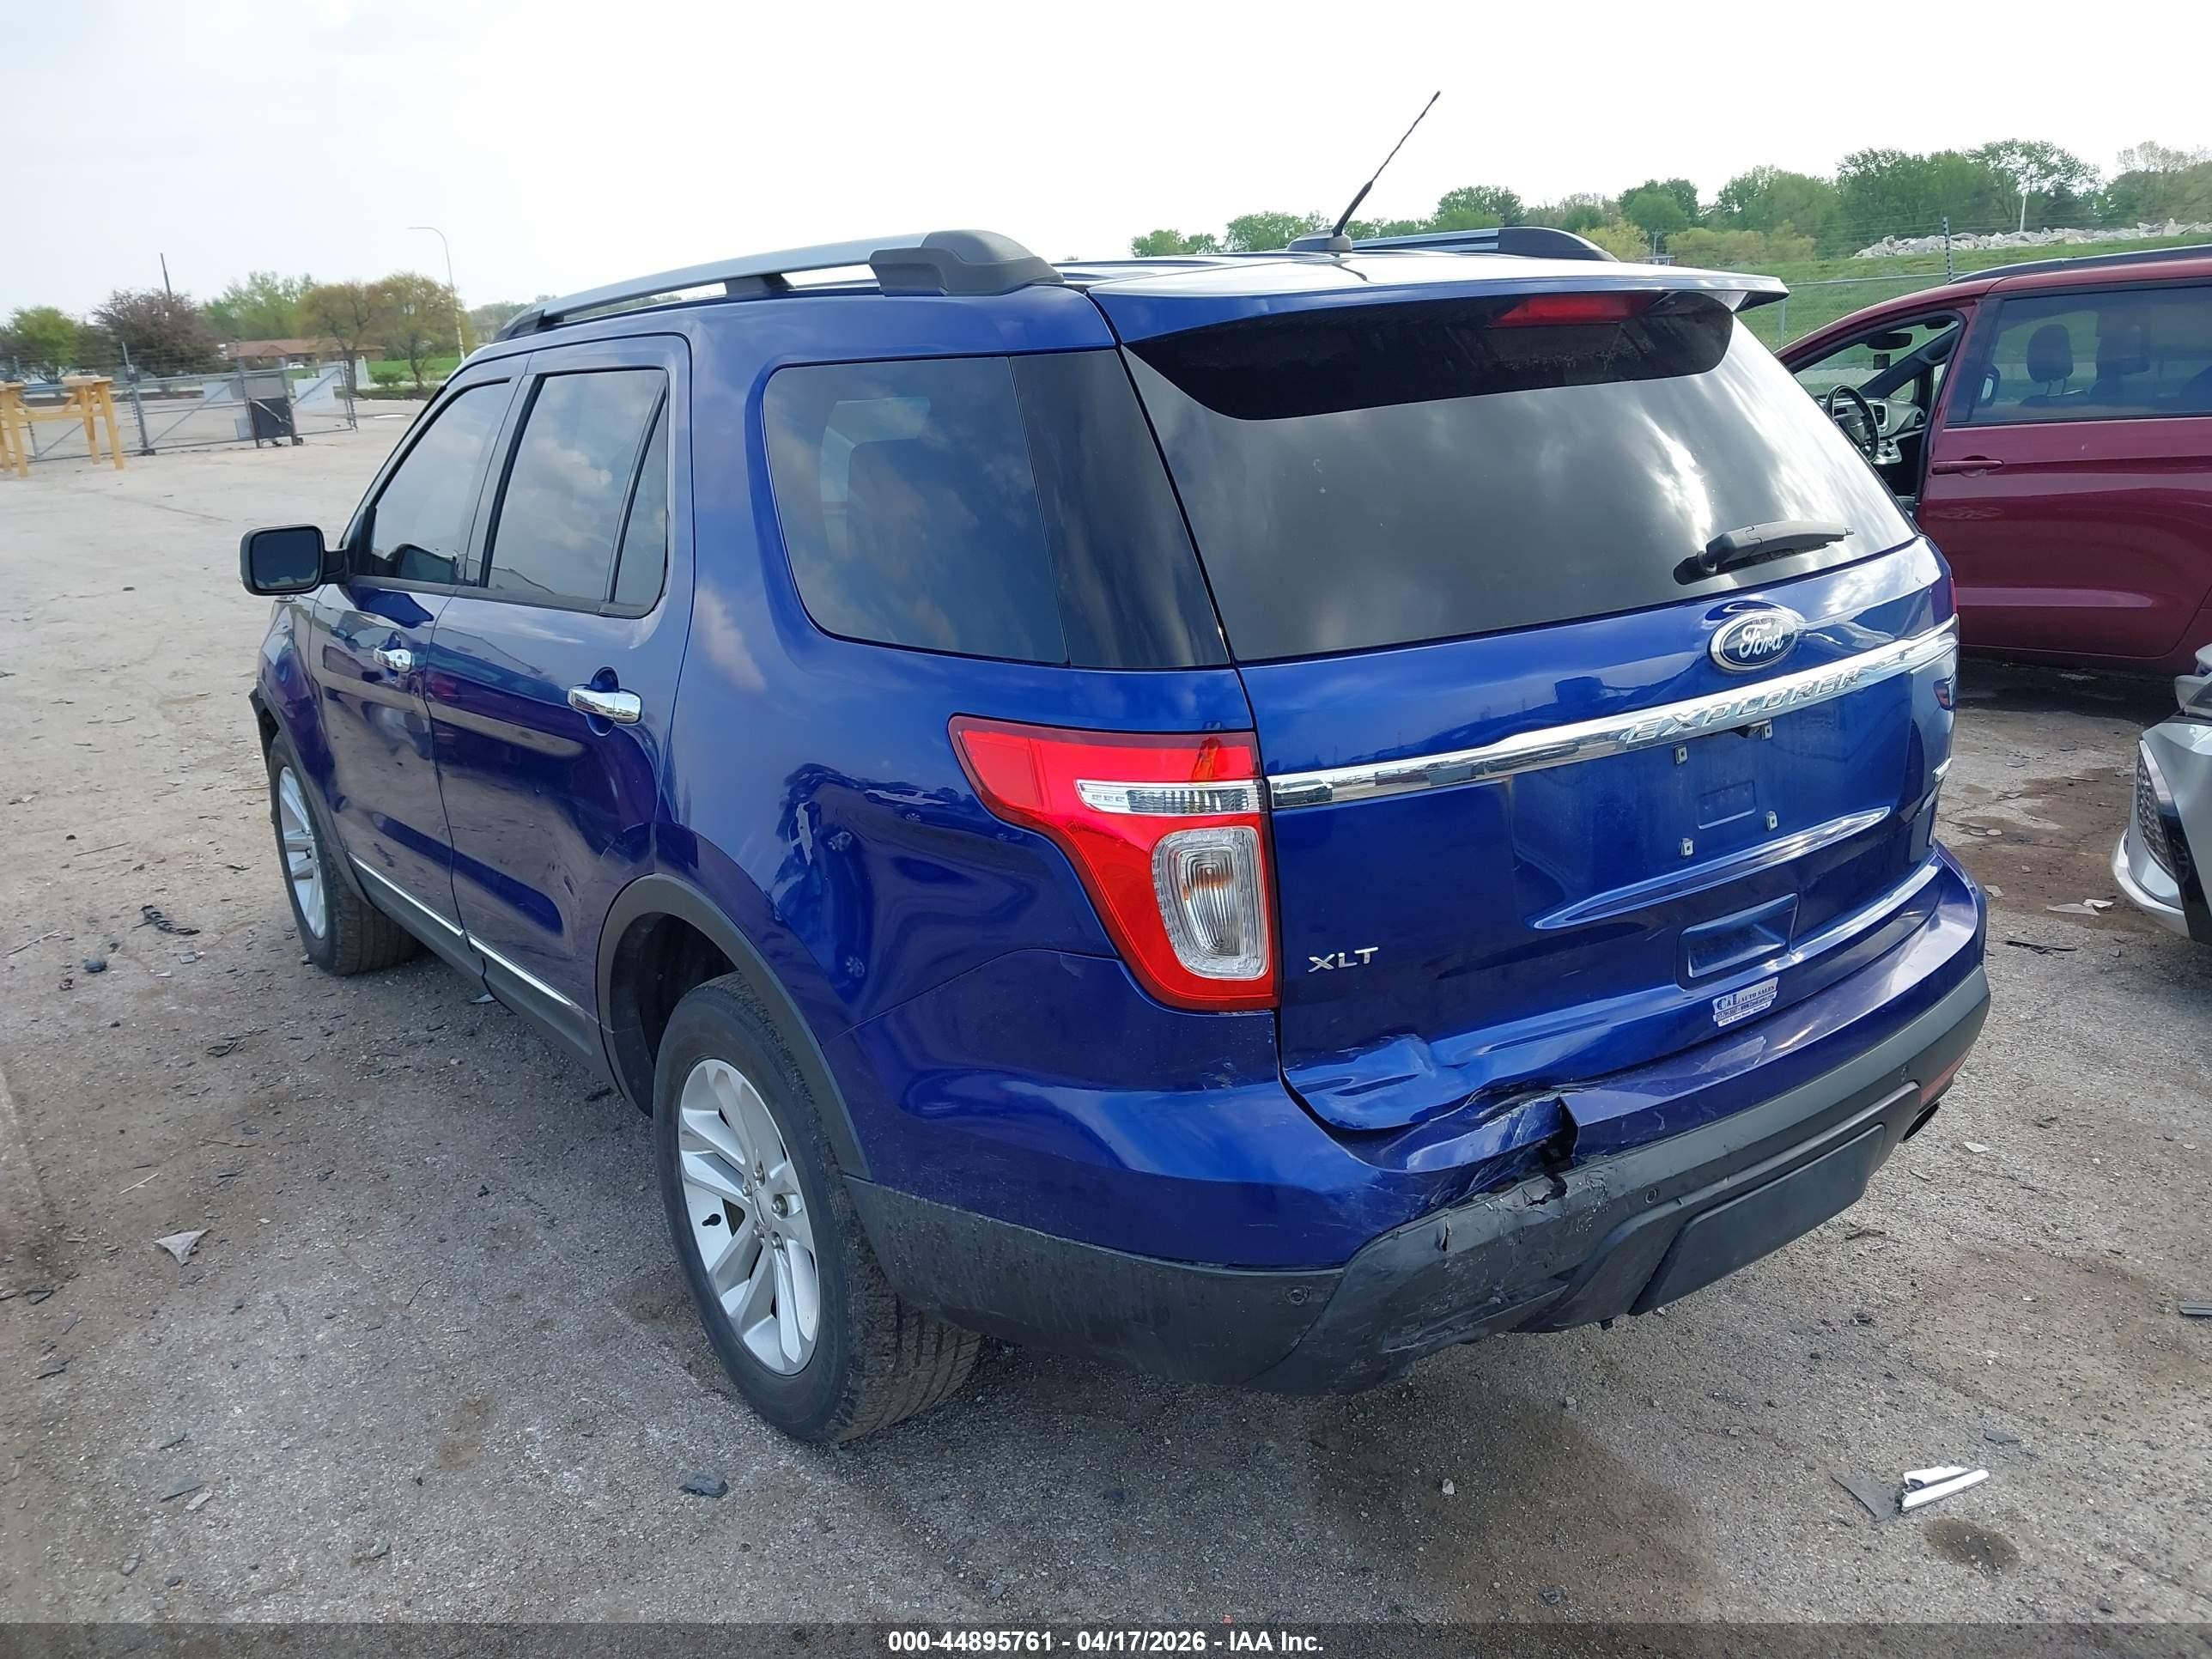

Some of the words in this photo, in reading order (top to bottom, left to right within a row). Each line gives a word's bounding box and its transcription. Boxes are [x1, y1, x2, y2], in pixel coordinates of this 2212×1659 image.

[1739, 623, 1784, 659] Ford
[1626, 667, 1863, 744] EXPLORER
[1308, 946, 1379, 973] XLT
